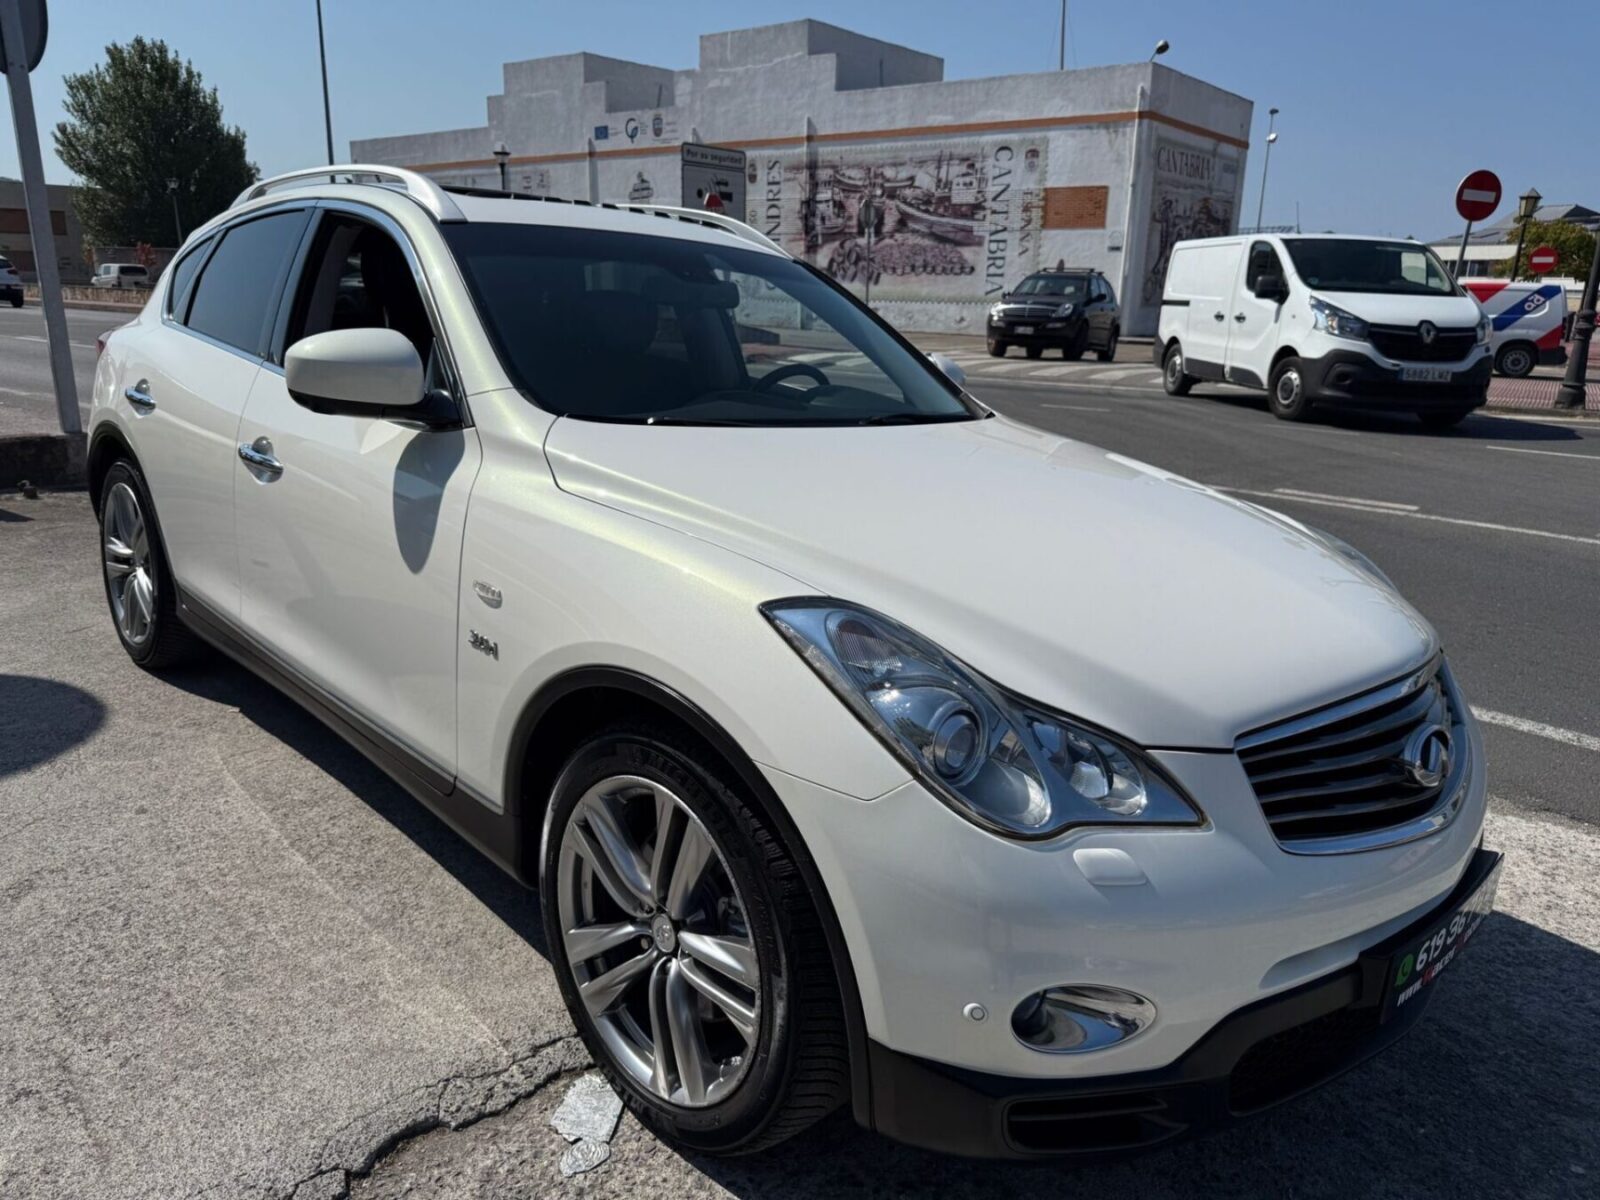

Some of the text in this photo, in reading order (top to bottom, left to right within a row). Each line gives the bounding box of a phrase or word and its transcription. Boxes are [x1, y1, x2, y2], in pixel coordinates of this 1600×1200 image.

[686, 147, 698, 157] Por
[710, 153, 744, 165] seguridad
[1157, 146, 1211, 181] CANTABRIA
[983, 145, 1014, 297] CANTABRIA
[1415, 927, 1447, 972] 619
